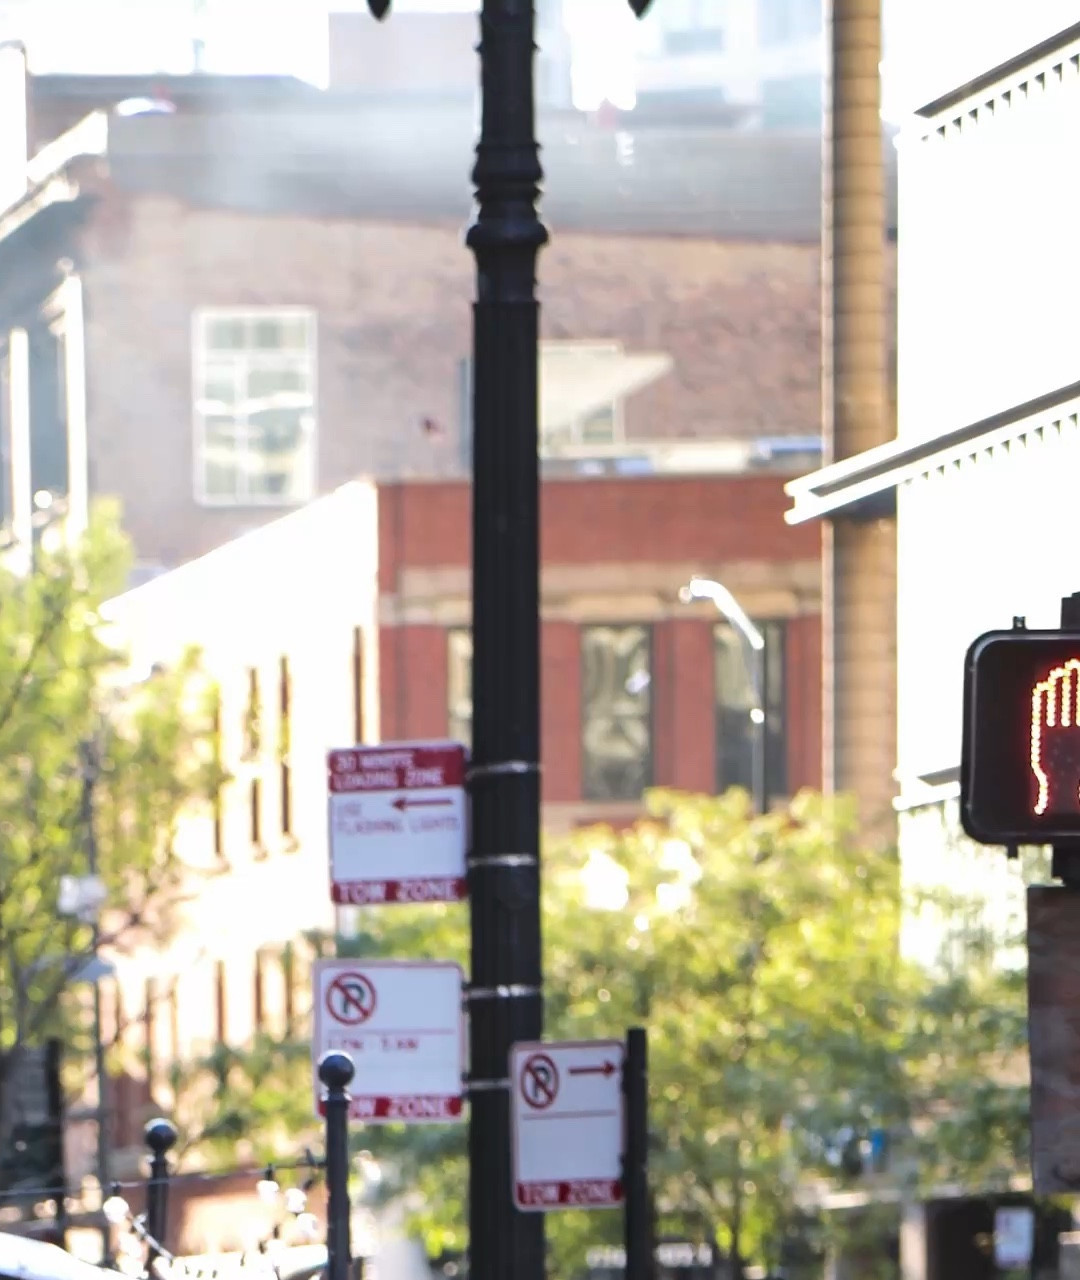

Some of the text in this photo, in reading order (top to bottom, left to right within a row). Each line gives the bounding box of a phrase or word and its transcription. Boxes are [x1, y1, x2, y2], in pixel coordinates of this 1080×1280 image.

[405, 767, 445, 785] ZONE
[339, 879, 456, 903] TOW ZONE
[388, 1096, 446, 1117] ZONE
[522, 1181, 612, 1205] TOW ZONE
